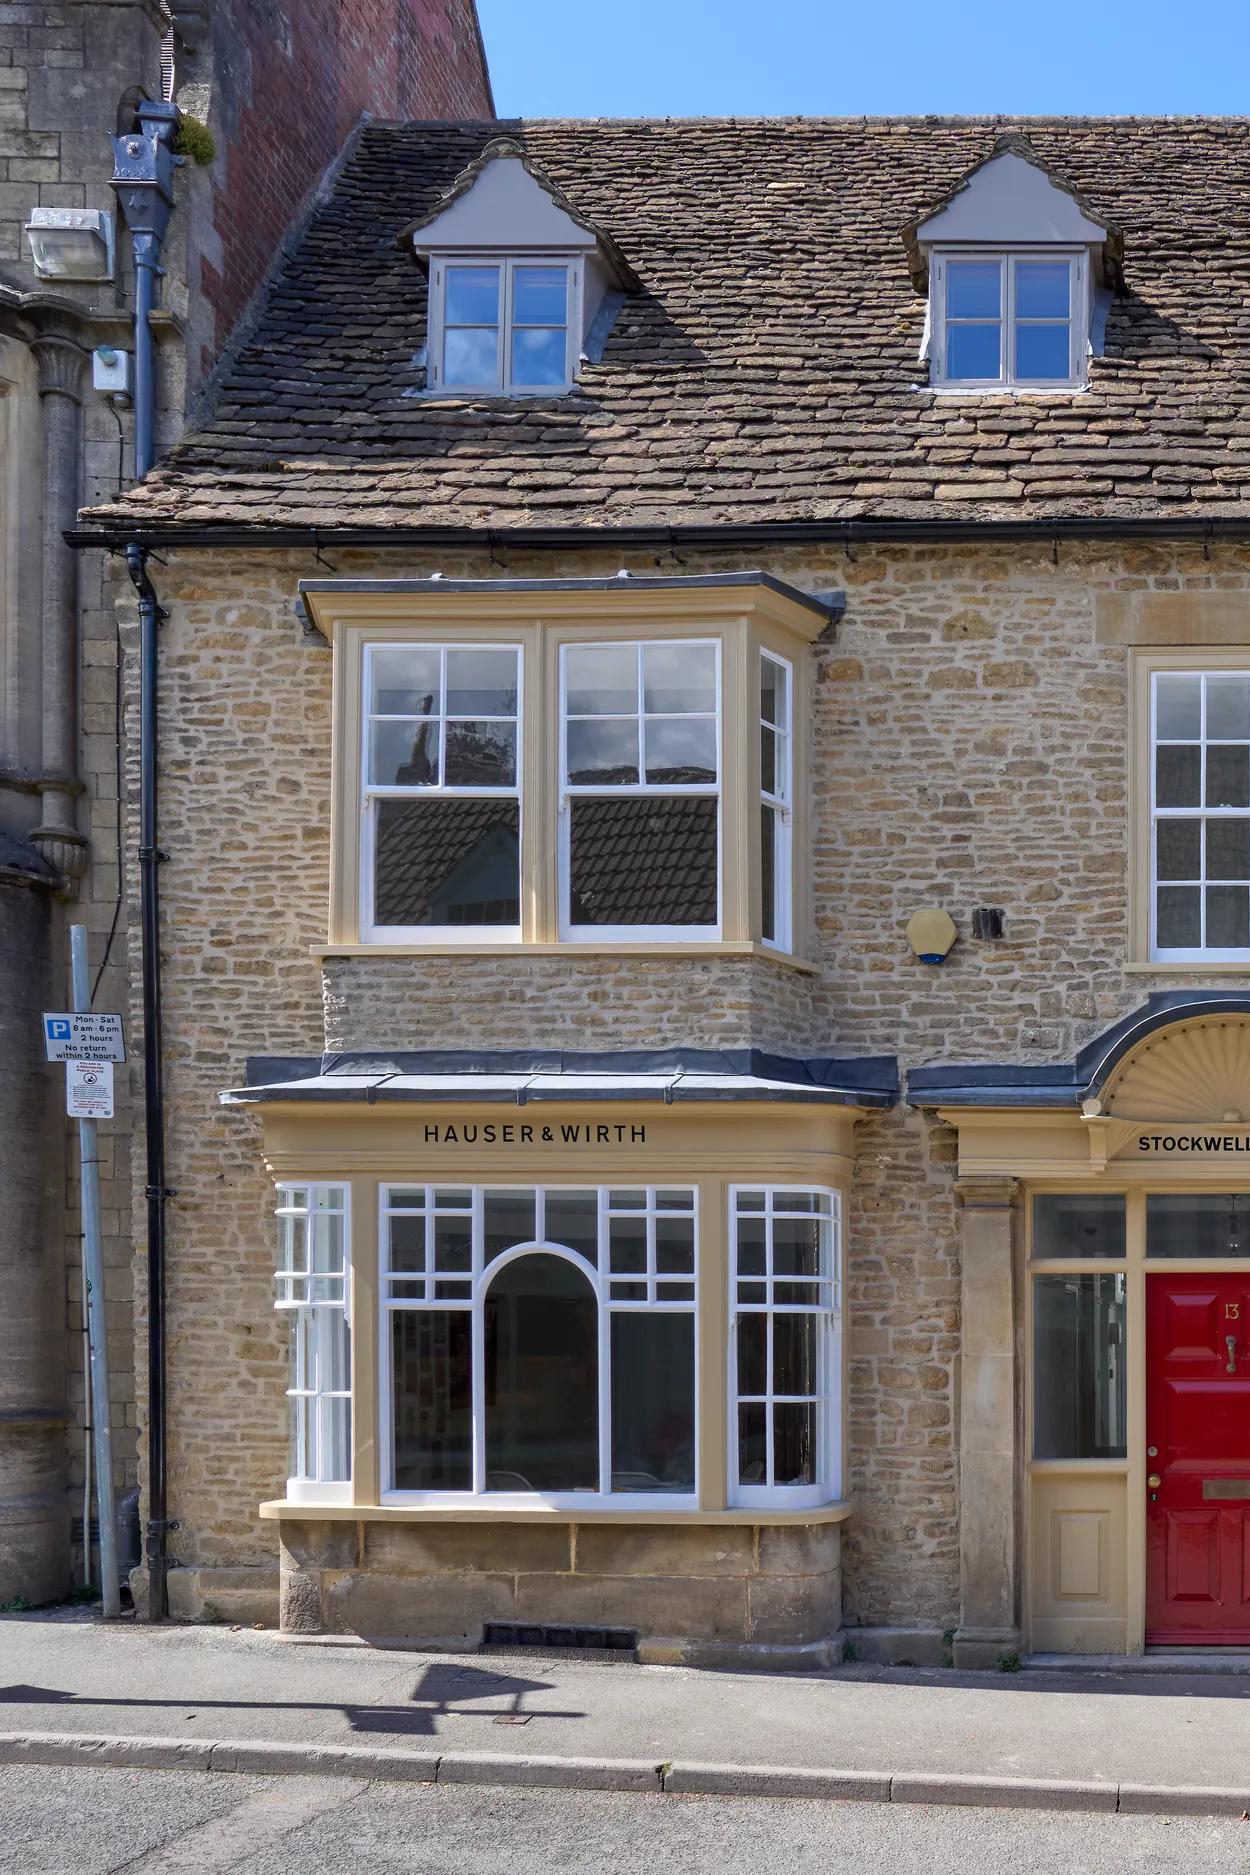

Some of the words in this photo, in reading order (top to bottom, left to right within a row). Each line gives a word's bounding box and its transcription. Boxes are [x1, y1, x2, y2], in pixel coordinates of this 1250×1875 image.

[52, 1021, 67, 1038] P
[93, 1052, 117, 1060] hours
[1225, 1303, 1240, 1320] 13
